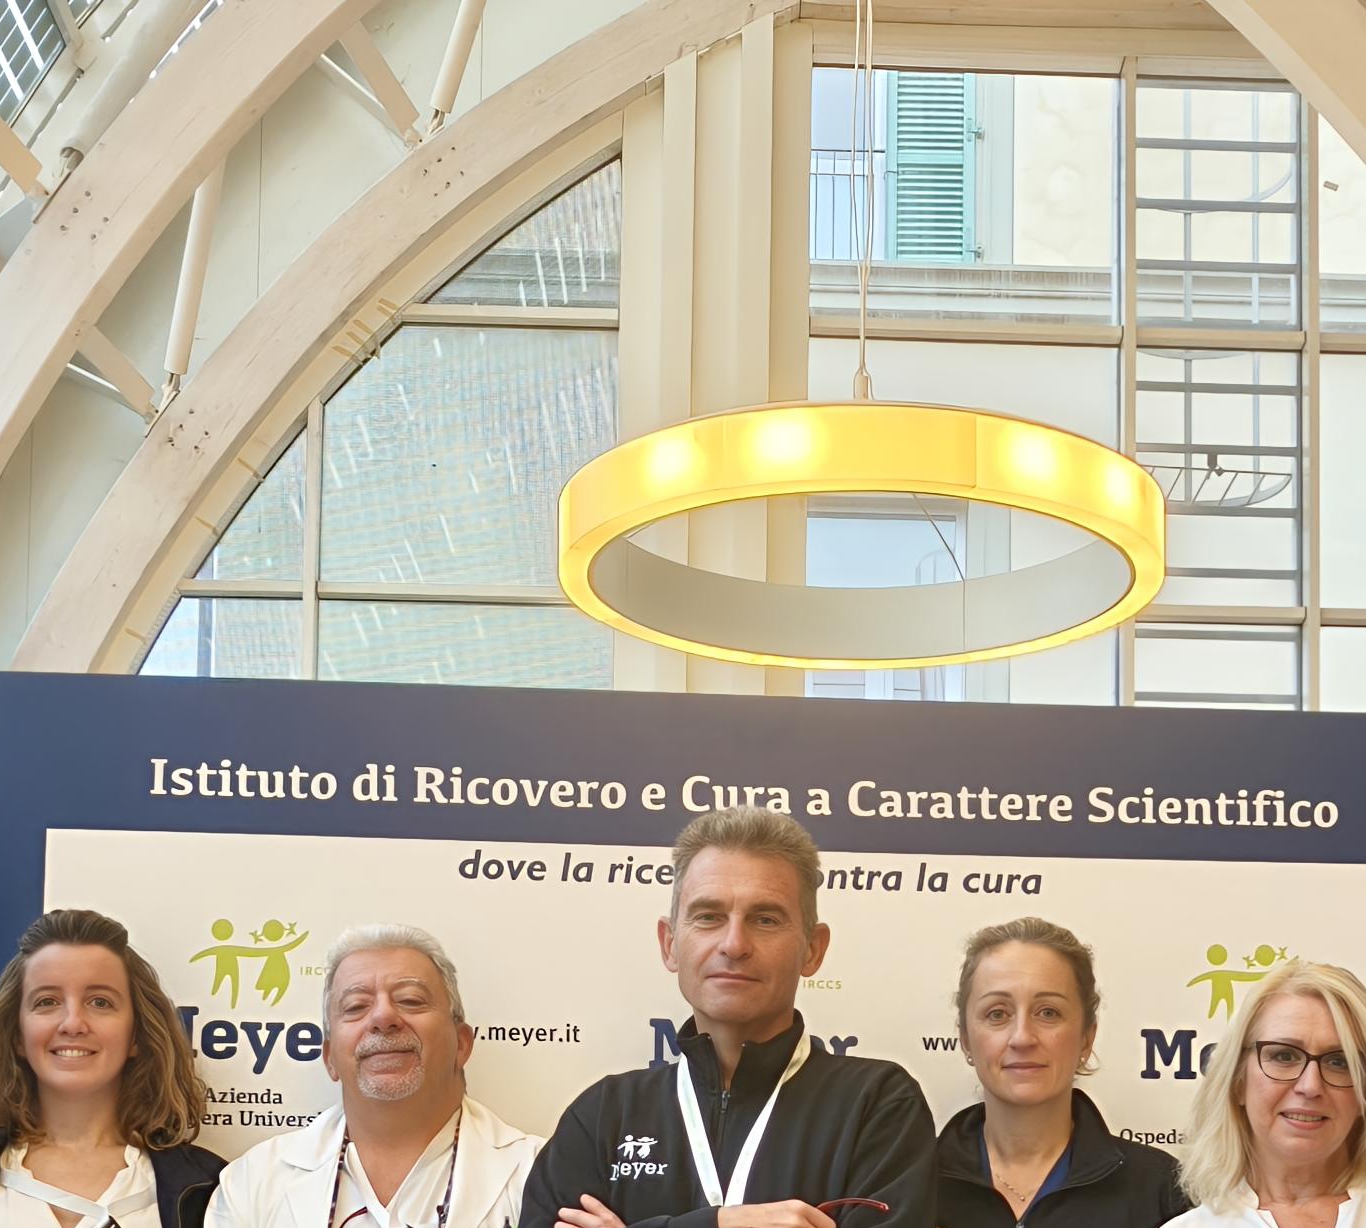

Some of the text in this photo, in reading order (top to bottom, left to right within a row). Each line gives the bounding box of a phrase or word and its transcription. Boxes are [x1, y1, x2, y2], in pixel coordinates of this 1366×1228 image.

[149, 757, 1340, 830] Istituto di Ricovero e Cura a Carattere Scientifico
[458, 849, 674, 886] dove la rice
[917, 861, 949, 894] la
[962, 869, 1043, 896] cura
[177, 1006, 322, 1075] eye
[473, 1023, 581, 1046] .meyer.it
[204, 1087, 283, 1105] Azienda
[240, 1110, 322, 1127] Univers
[1120, 1128, 1188, 1146] Ospeda
